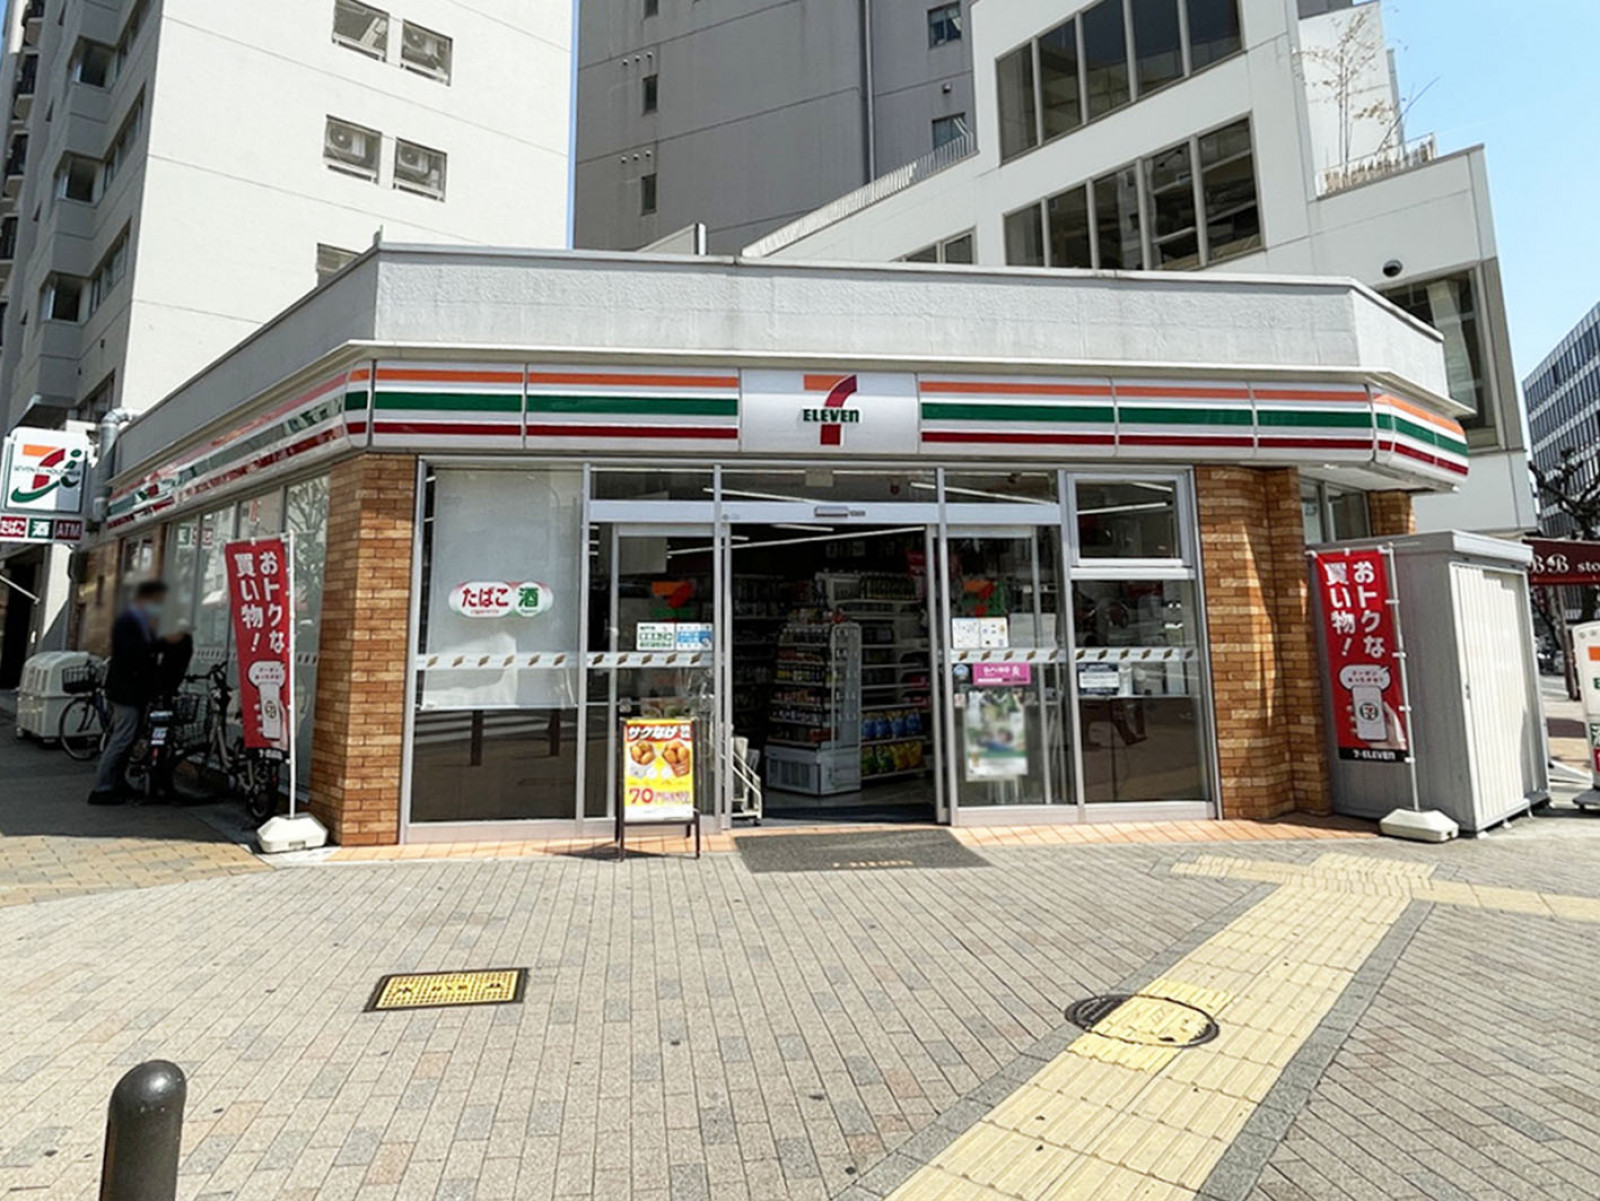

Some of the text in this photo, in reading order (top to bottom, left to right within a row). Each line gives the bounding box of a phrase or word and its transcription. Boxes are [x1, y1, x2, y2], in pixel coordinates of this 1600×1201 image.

[57, 522, 81, 539] ATM
[260, 551, 285, 654] おトクな
[462, 587, 539, 608] たばこ 酒
[1353, 561, 1386, 658] おトクな
